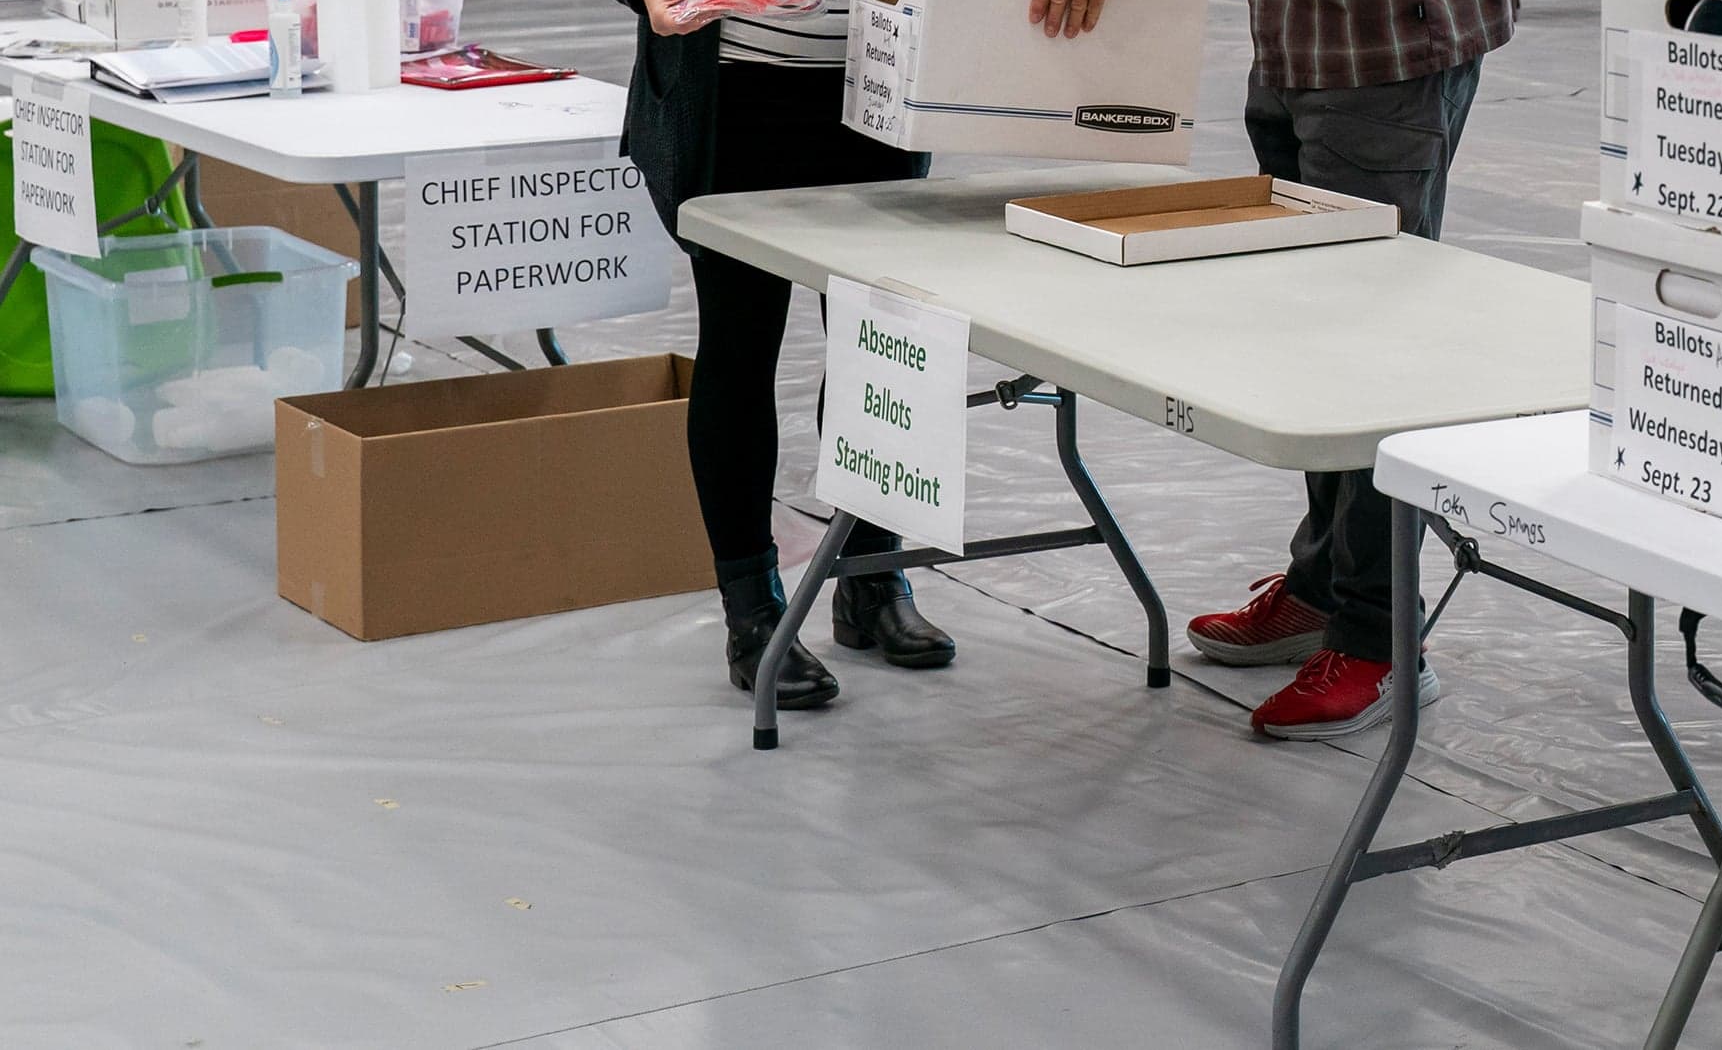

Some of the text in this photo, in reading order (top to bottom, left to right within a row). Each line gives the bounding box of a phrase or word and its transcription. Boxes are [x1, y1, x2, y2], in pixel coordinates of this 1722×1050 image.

[871, 11, 892, 32] Ballots
[866, 42, 895, 67] Returned
[863, 75, 892, 102] Saturday,
[15, 98, 84, 136] CHIEF INSPECTOR
[863, 110, 874, 127] Oct.
[876, 115, 884, 132] 24
[1081, 111, 1170, 127] BANKERS BOX
[21, 140, 75, 174] STATION FOR
[21, 180, 75, 216] PAPERWORK
[422, 162, 641, 205] CHIEF INSPECTO
[1658, 184, 1699, 215] Sept.
[452, 212, 631, 249] STATION FOR
[458, 255, 627, 294] PAPERWORK
[858, 319, 926, 371] Absentee
[1655, 321, 1713, 359] Ballots
[1644, 365, 1722, 409] Returned
[864, 383, 911, 430] Ballots
[1166, 396, 1194, 433] EHS
[835, 436, 940, 506] Starting Point
[1642, 461, 1711, 503] Sept. 23
